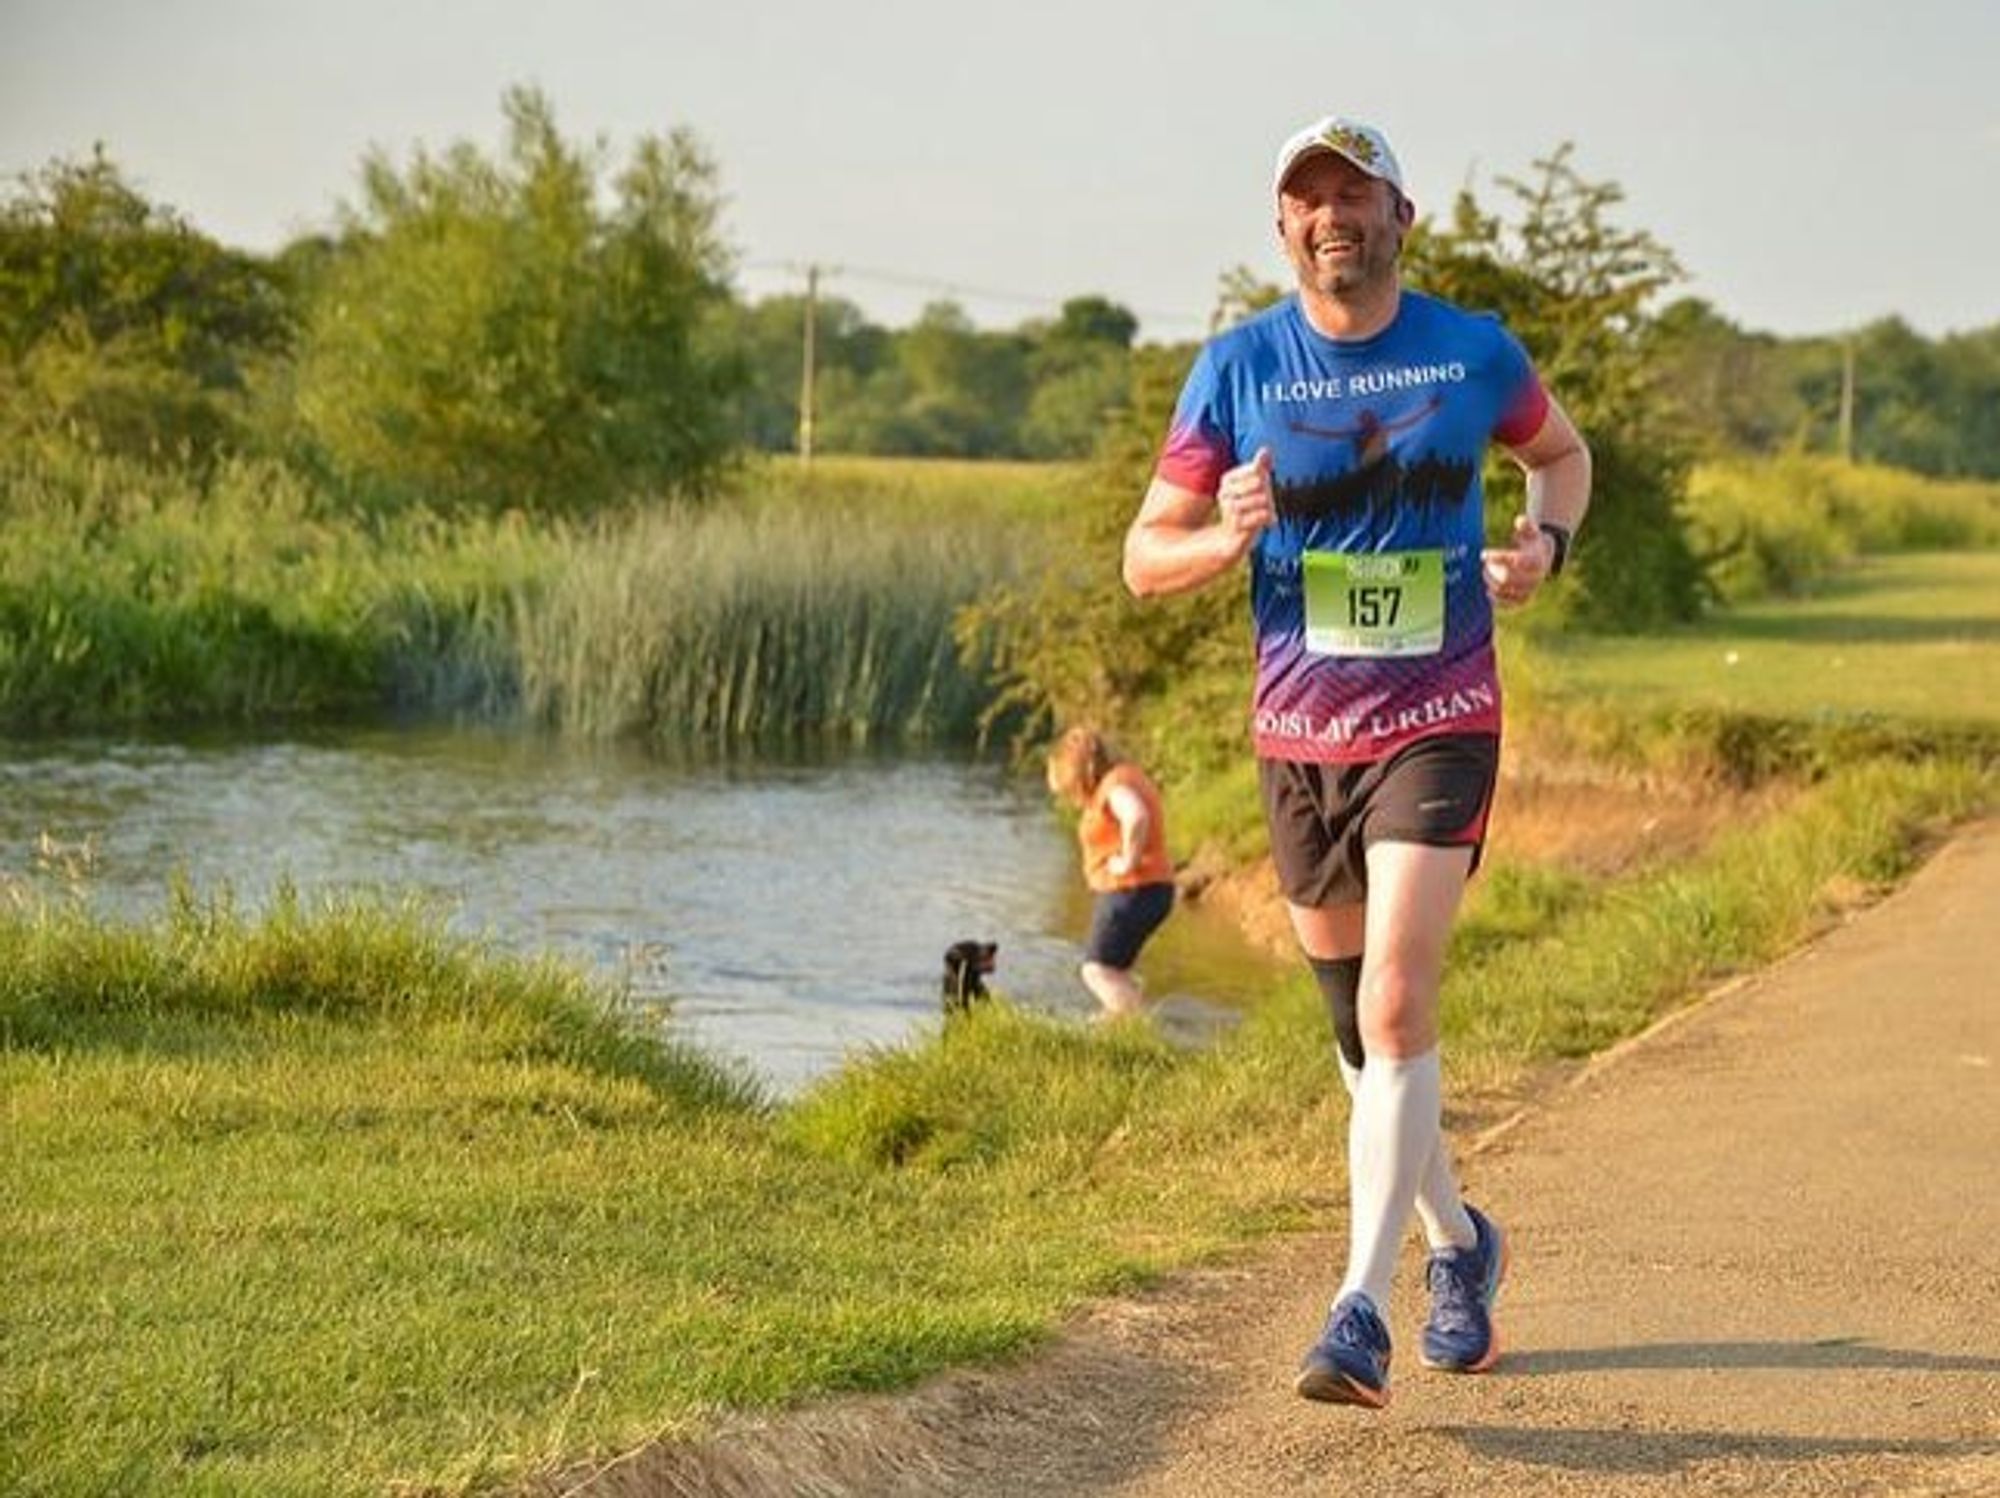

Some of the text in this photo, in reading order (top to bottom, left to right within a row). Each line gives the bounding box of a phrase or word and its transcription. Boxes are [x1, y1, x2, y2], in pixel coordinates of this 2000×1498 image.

[1277, 378, 1342, 402] LOVE
[1350, 362, 1466, 397] RUNNING
[1349, 586, 1401, 627] 157
[1371, 683, 1494, 737] URBAN
